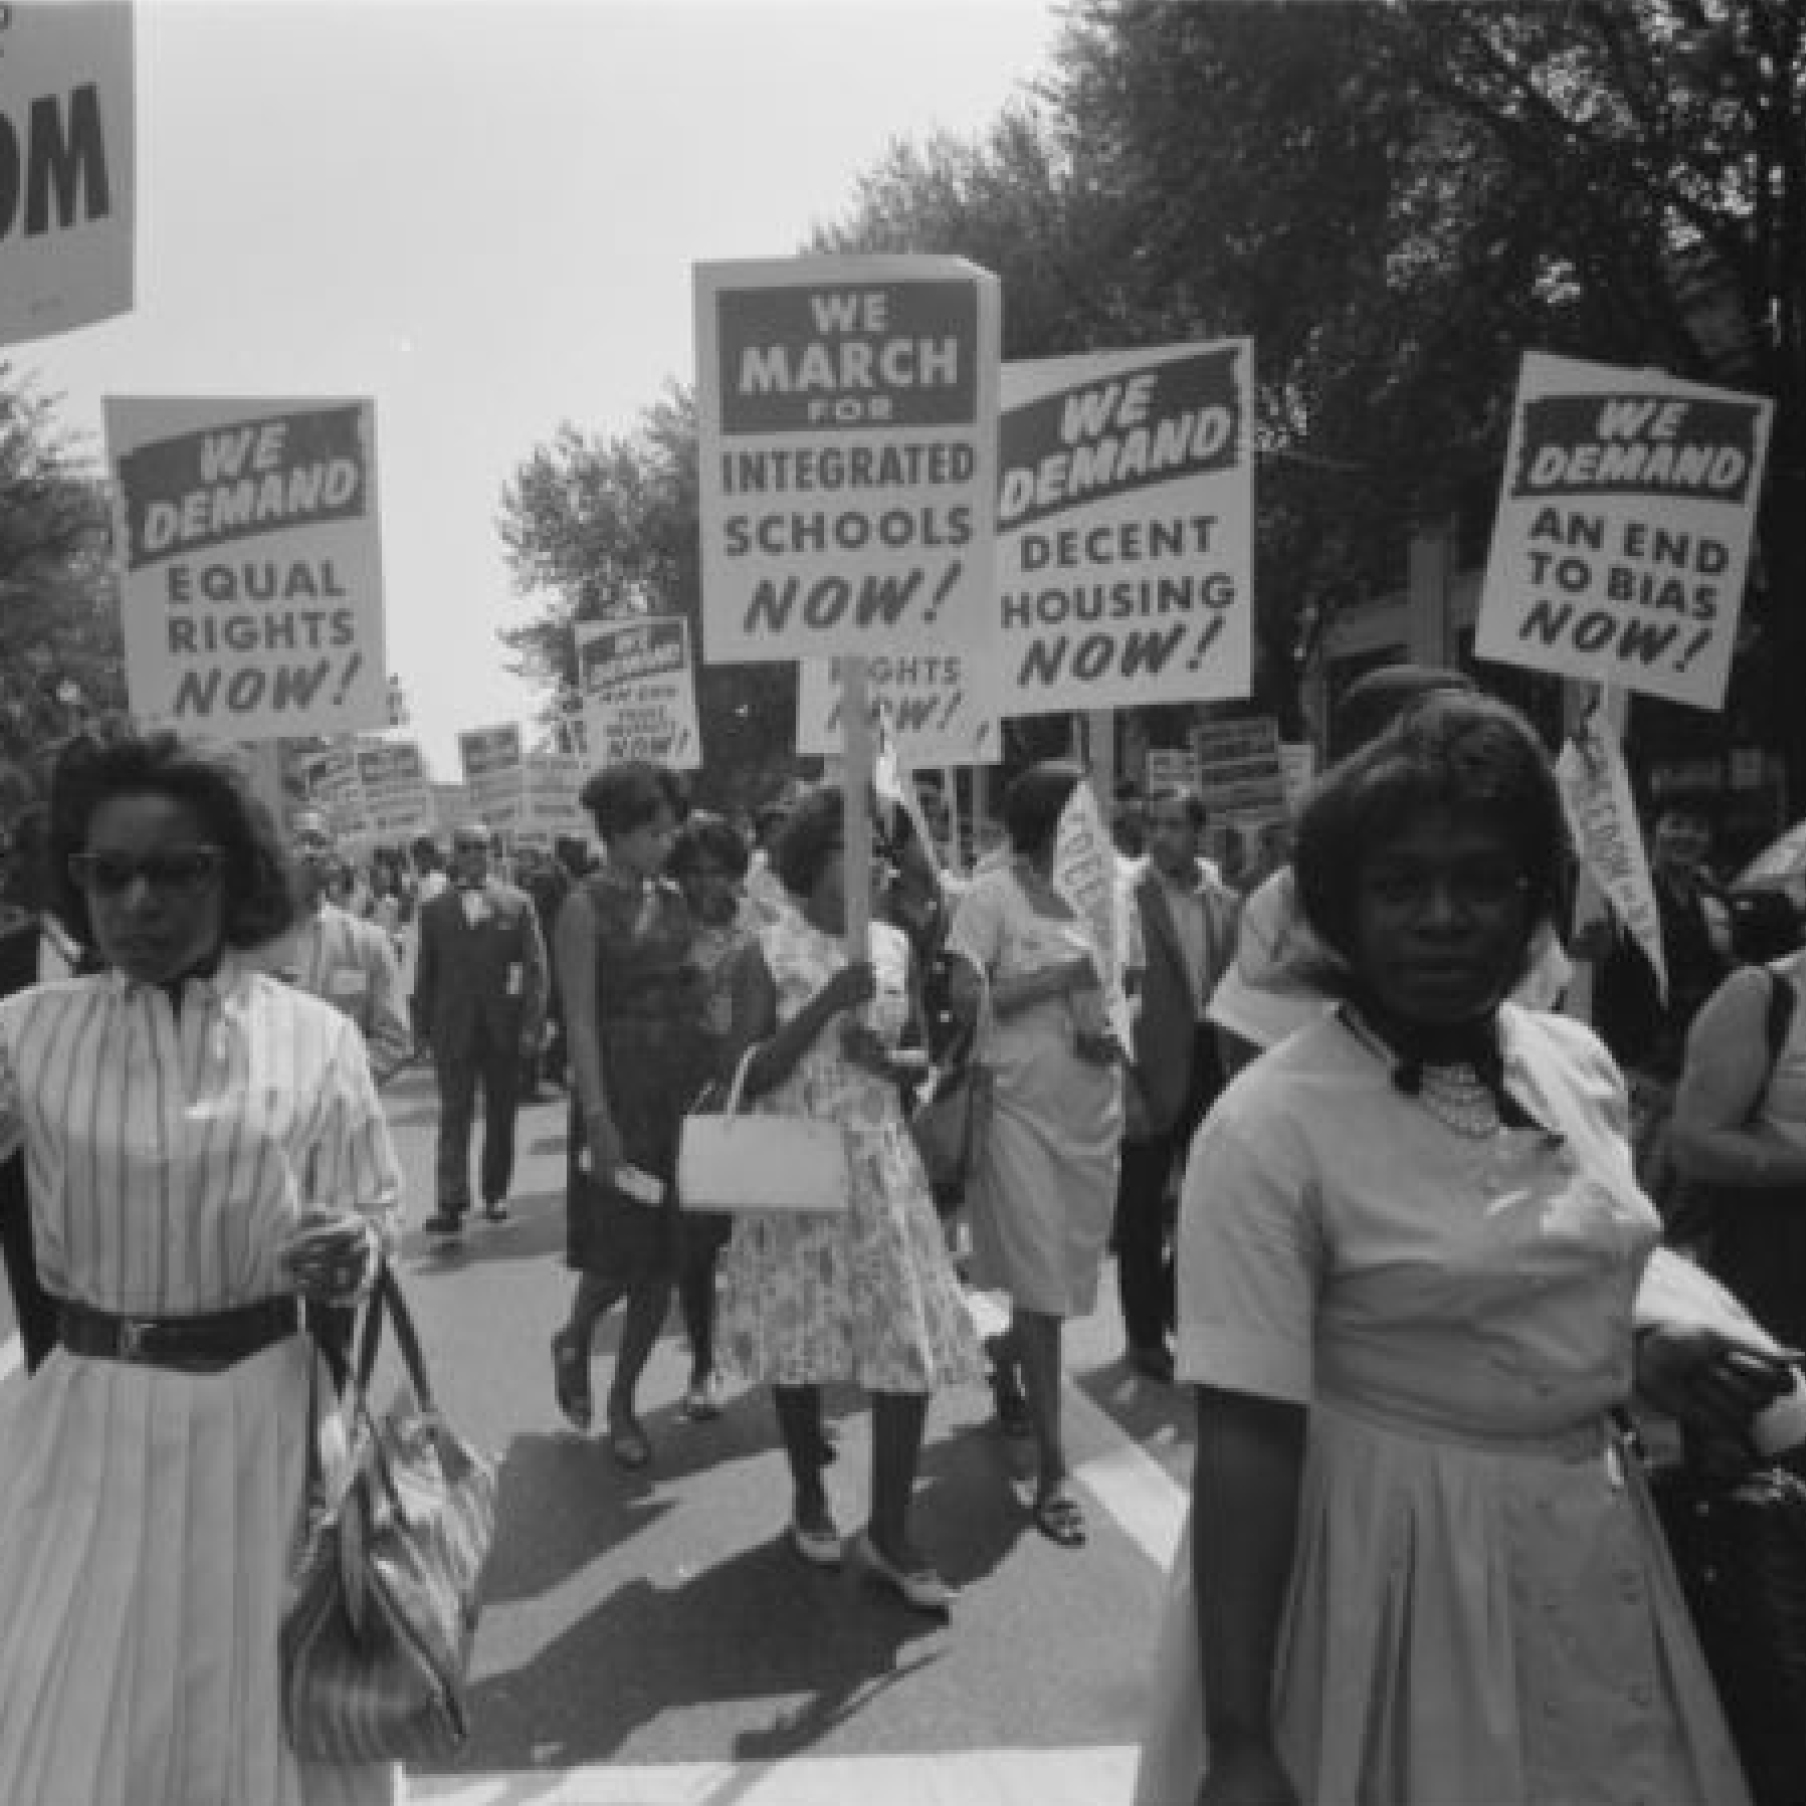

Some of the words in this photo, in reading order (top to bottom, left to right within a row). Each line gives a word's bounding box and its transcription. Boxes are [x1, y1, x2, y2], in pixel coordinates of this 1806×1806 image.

[811, 293, 888, 335] WE
[738, 338, 958, 392] MARCH
[808, 397, 893, 423] FOR
[1062, 374, 1156, 445] WE
[1597, 399, 1691, 441] WE
[203, 421, 288, 482] WE
[722, 443, 974, 494] INTEGRATED
[1000, 404, 1232, 518] DEMAND
[1530, 444, 1746, 489] DEMAND
[144, 458, 359, 551] DEMAND
[723, 506, 973, 557] SCHOOLS
[1019, 513, 1218, 574] DECENT
[1528, 506, 1605, 550] AN
[1623, 523, 1730, 577] END
[167, 559, 347, 604] EQUAL
[743, 559, 963, 635] NOW!
[1000, 571, 1235, 629] HOUSING
[1527, 549, 1593, 593] TO
[1608, 566, 1718, 622] BIAS
[167, 607, 356, 656] RIGHTS
[1016, 614, 1226, 687] NOW!
[1517, 599, 1713, 673] NOW!
[173, 651, 362, 717] NOW!
[830, 655, 962, 687] GHTS
